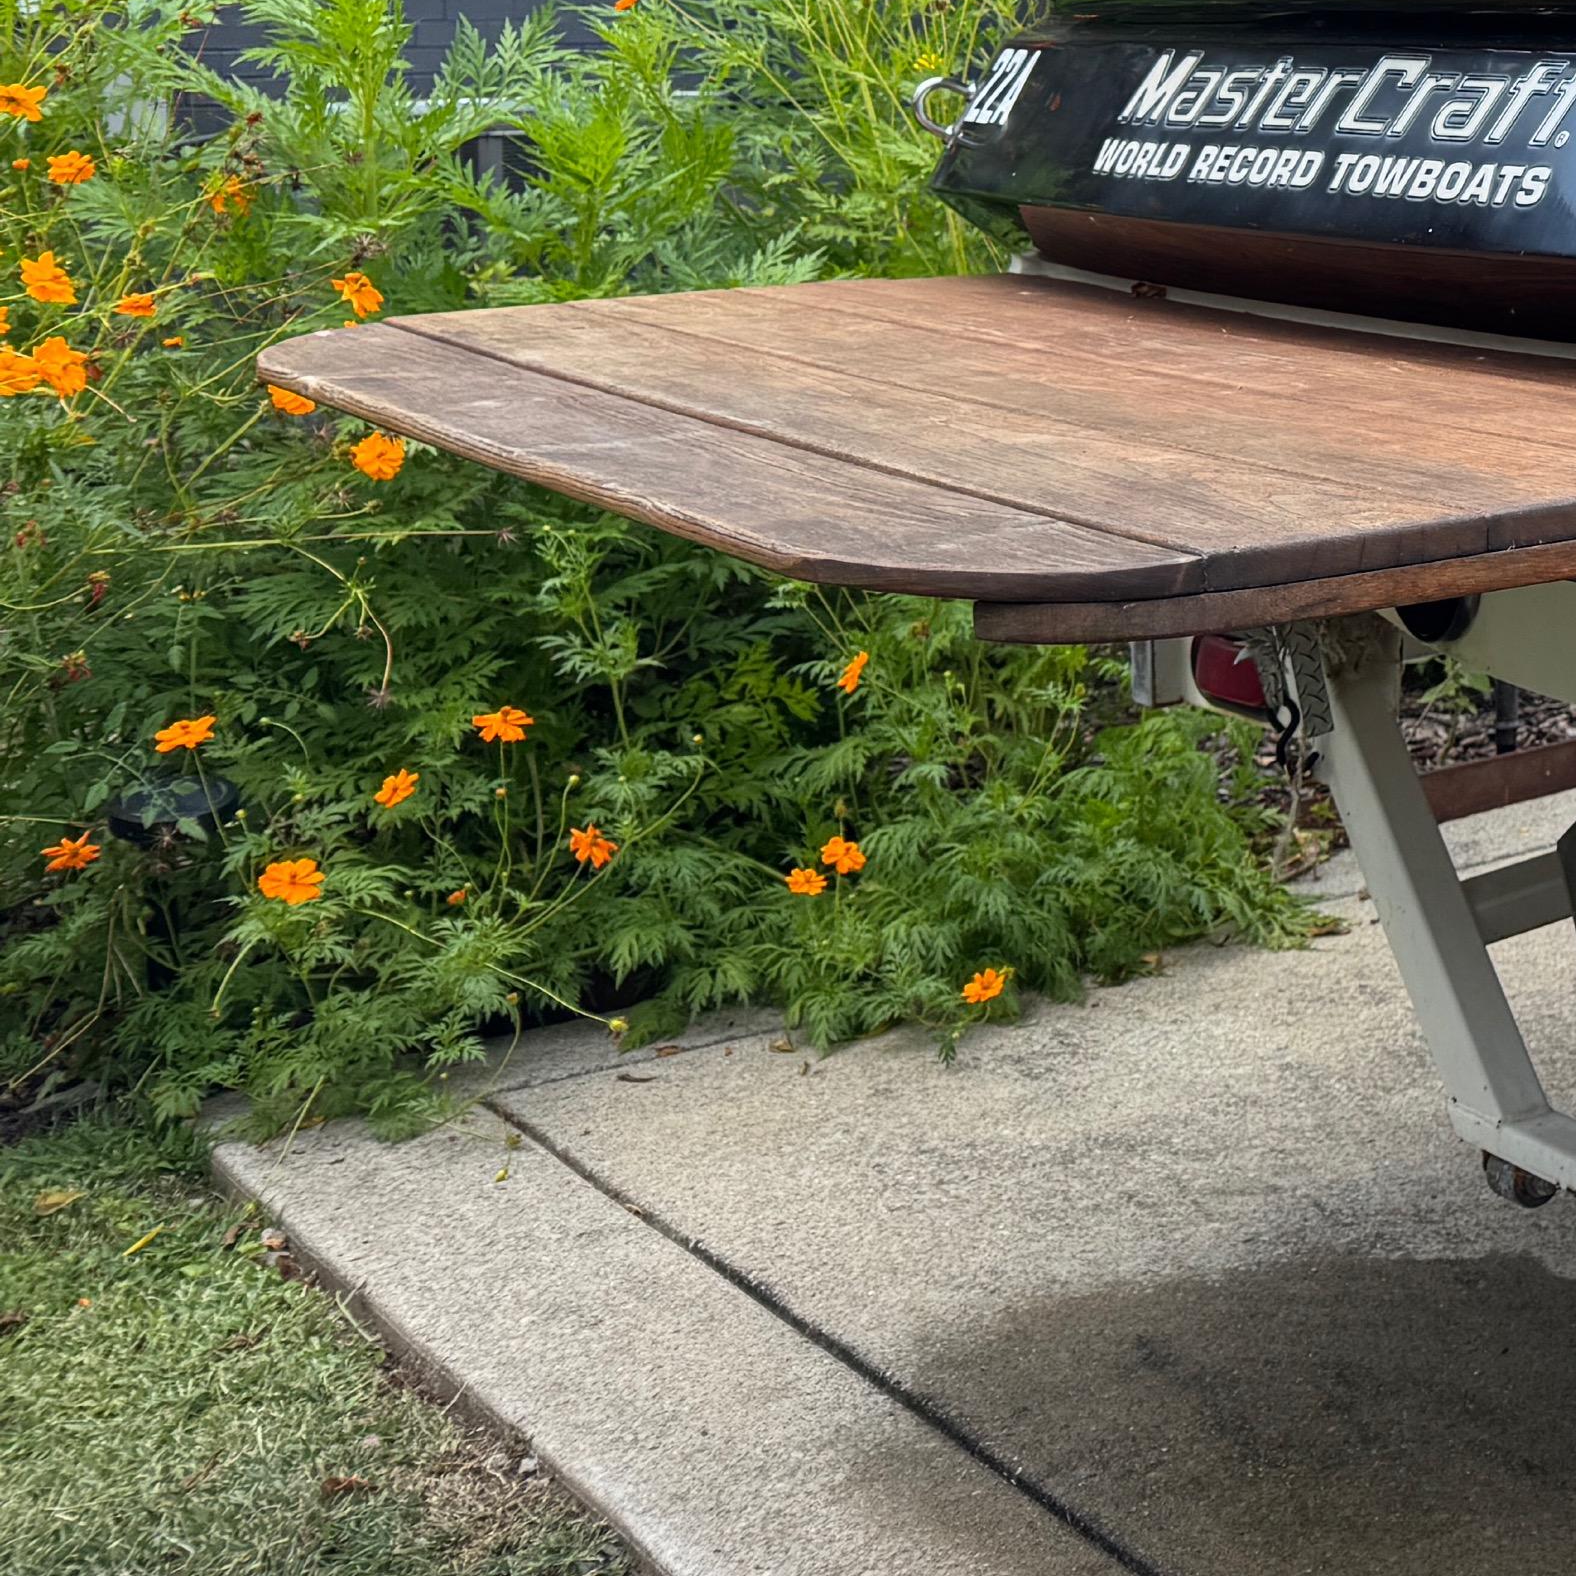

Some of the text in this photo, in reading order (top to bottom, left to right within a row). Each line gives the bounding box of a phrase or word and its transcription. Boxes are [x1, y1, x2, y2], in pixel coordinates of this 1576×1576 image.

[963, 48, 1042, 125] 22A
[1092, 136, 1553, 209] WORLD RECORD TOWBOATS
